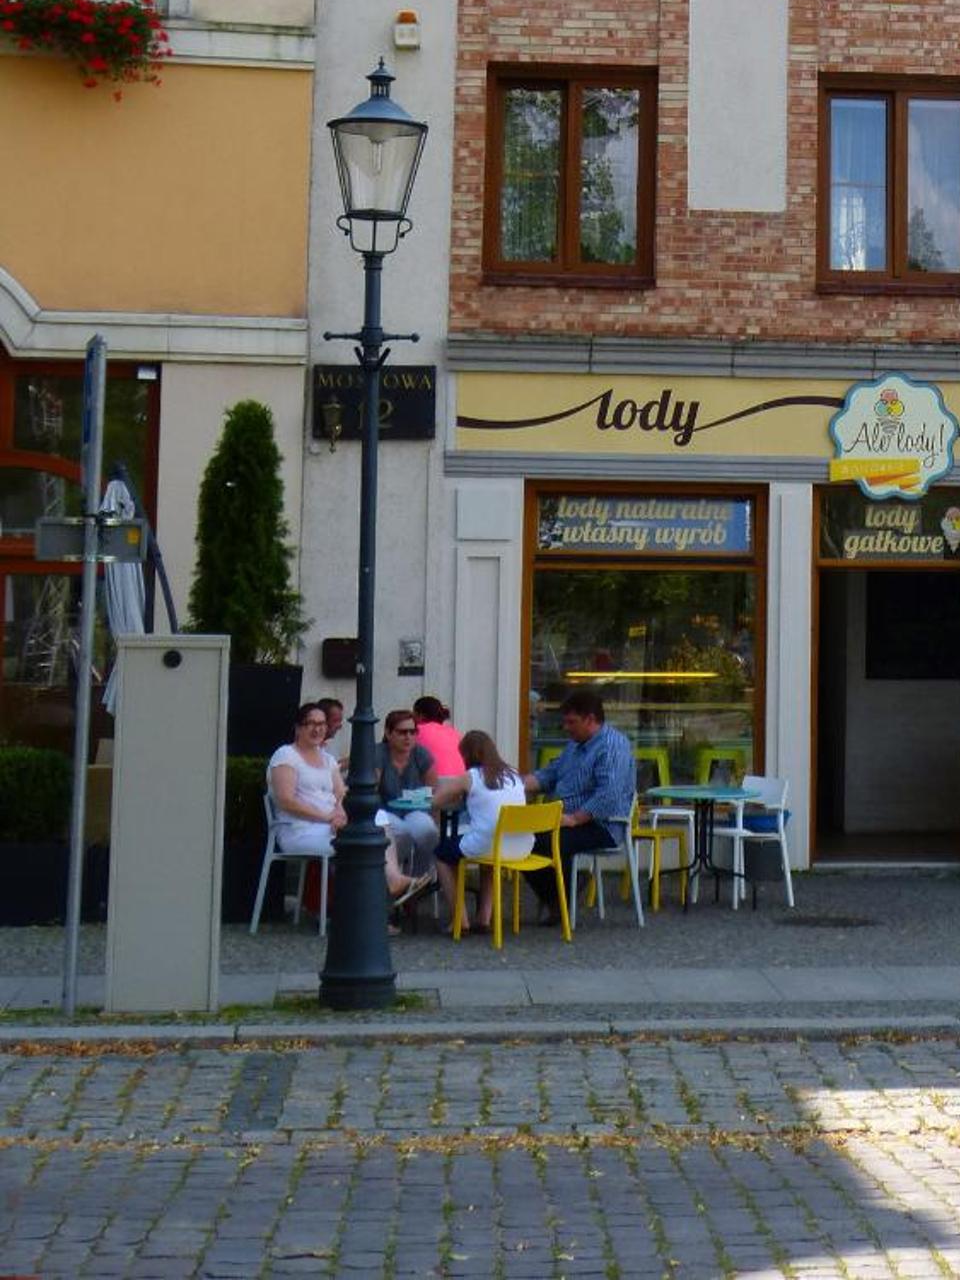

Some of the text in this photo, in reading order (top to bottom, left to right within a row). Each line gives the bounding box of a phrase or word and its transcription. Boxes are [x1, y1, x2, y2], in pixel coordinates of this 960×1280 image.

[319, 372, 433, 391] MOSOWA
[596, 388, 700, 447] lody
[844, 421, 946, 469] Ale lody!
[557, 496, 610, 524] lody
[864, 504, 918, 534] lody
[562, 522, 727, 551] własny wyrób
[844, 529, 944, 559] gałkowe
